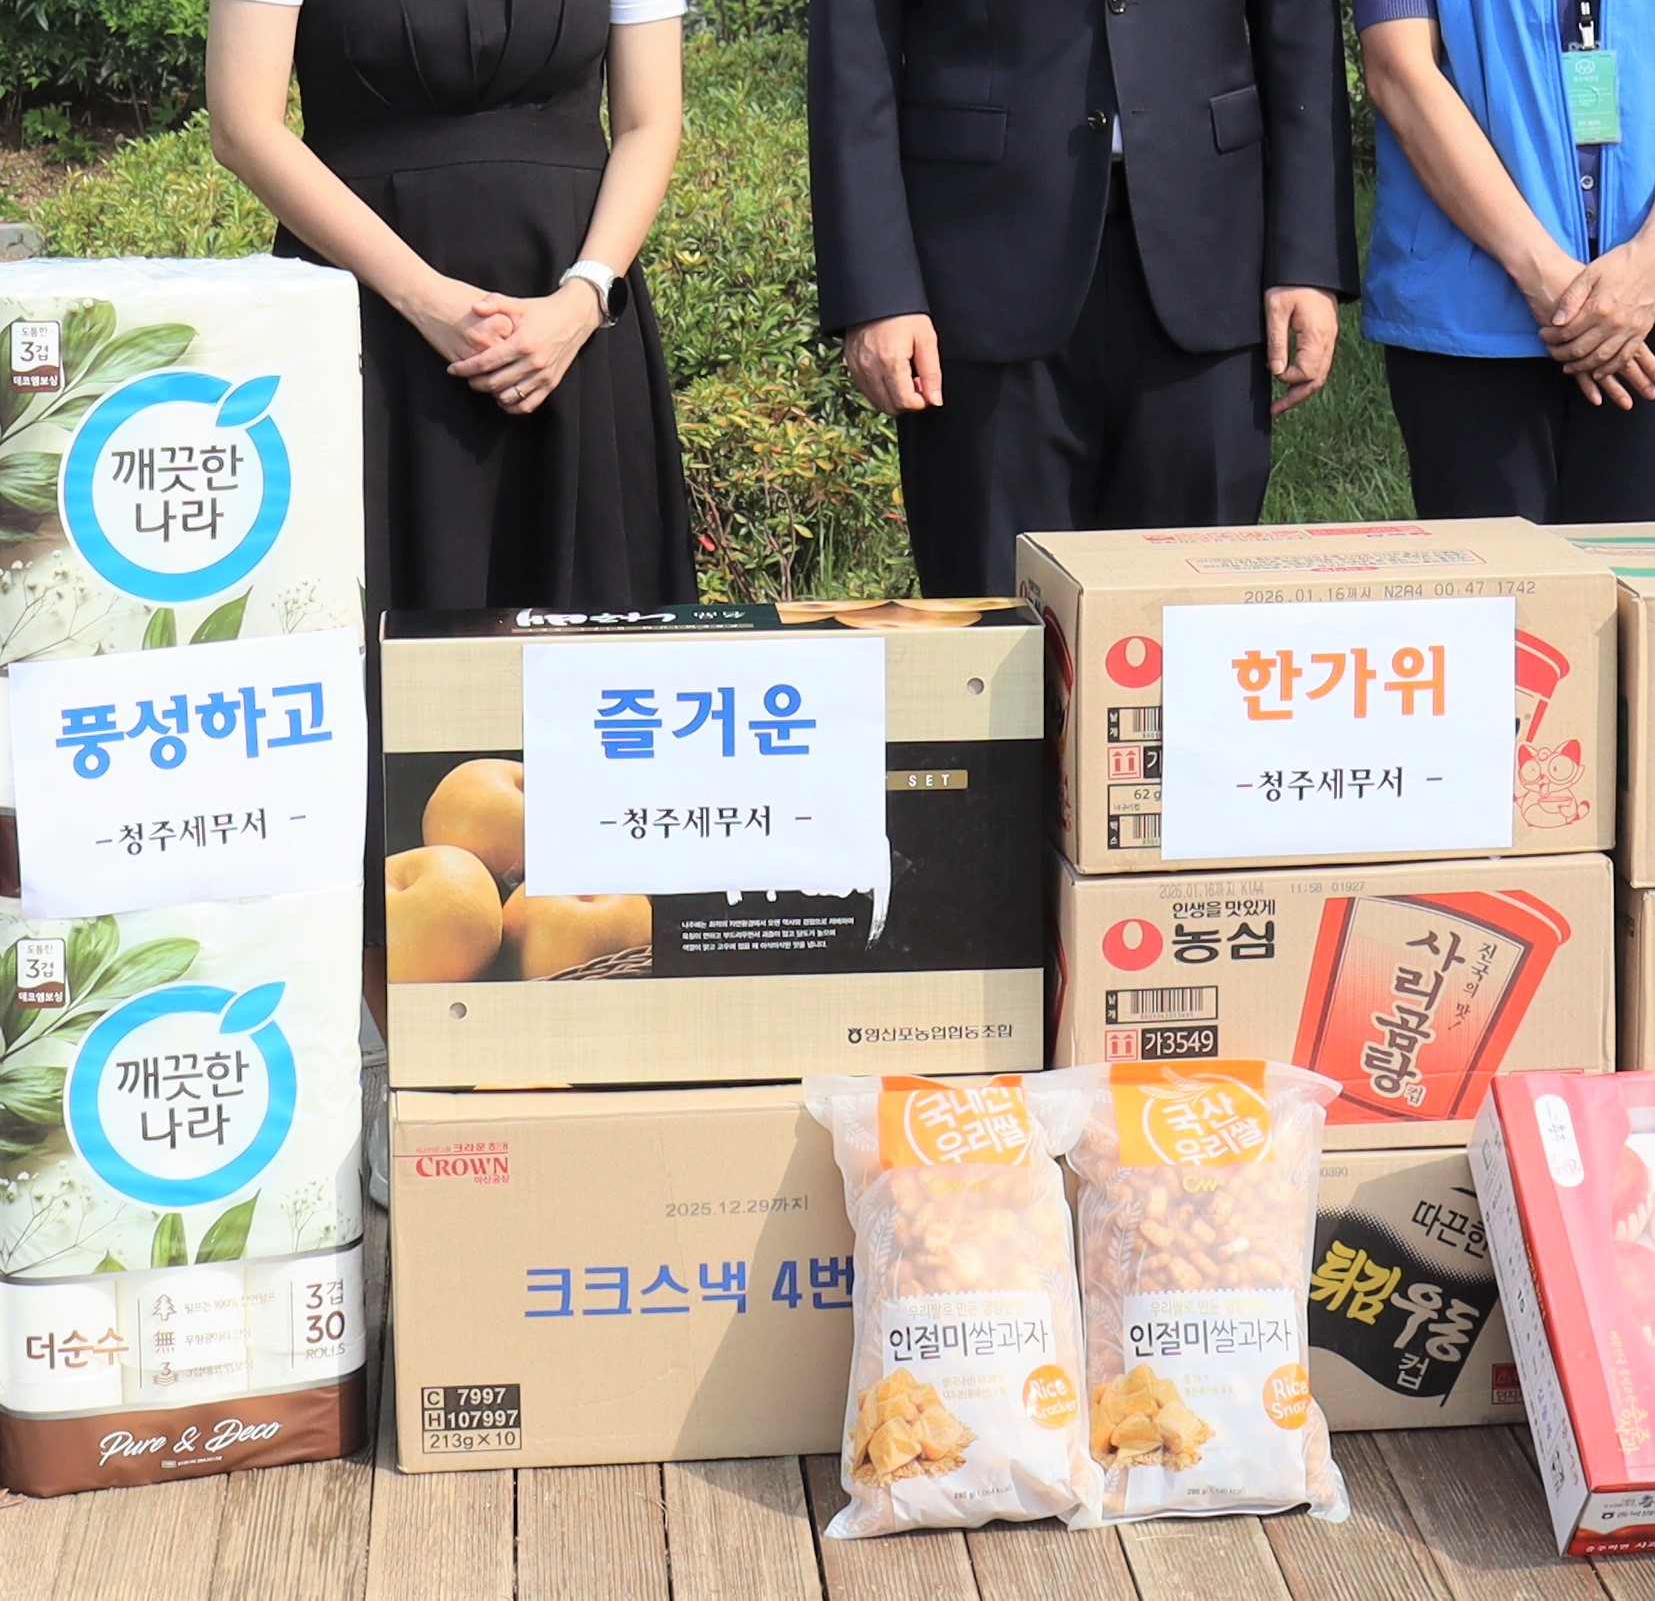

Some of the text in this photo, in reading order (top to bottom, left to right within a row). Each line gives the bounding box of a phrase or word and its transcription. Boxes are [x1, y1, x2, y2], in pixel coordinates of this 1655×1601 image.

[20, 326, 49, 337] 도톰한
[20, 341, 49, 362] 3겹
[111, 444, 244, 494] 깨끗한
[134, 497, 225, 543] 나라
[1497, 581, 1536, 595] 1742
[1231, 645, 1445, 722] 한가위
[56, 682, 333, 779] 풍성하고
[594, 683, 817, 760] 즐거운
[908, 774, 951, 787] SET
[1133, 788, 1149, 800] 62
[1172, 899, 1276, 920] 인생을 맛있게
[1171, 920, 1275, 964] 농심
[25, 958, 55, 978] 3겹
[1463, 942, 1498, 999] 진국의
[1364, 930, 1466, 1094] 사리곰탕
[865, 1024, 1013, 1042] 영산포농업협동조합
[1145, 1030, 1214, 1056] 가3549
[115, 1050, 250, 1101] 깨끗한
[140, 1104, 231, 1149] 나라
[916, 1086, 1013, 1129] 국내산
[1161, 1091, 1239, 1135] 국산
[936, 1113, 1028, 1164] 우리쌀
[1173, 1117, 1266, 1166] 우리쌀
[415, 1156, 508, 1178] CROWN
[665, 1195, 809, 1218] 2025.12.29까지
[1411, 1200, 1488, 1259] 따끈한
[306, 1278, 344, 1309] 3겹
[523, 1260, 748, 1318] 크크스낵
[306, 1310, 346, 1344] 30
[908, 1303, 954, 1320] 우리쌀로
[955, 1302, 978, 1317] 만든
[1150, 1301, 1195, 1317] 우리쌀로
[26, 1327, 129, 1370] 더순수
[306, 1342, 346, 1359] ROLLS
[889, 1319, 1049, 1362] 인절미쌀과자
[1129, 1318, 1292, 1358] 인절미쌀과자
[1029, 1376, 1067, 1400] Rice
[1271, 1378, 1309, 1401] Rice
[1397, 1352, 1430, 1390] 컵
[427, 1387, 507, 1407] C 7997
[427, 1409, 519, 1429] H 107997
[98, 1418, 283, 1466] Pure & Deco
